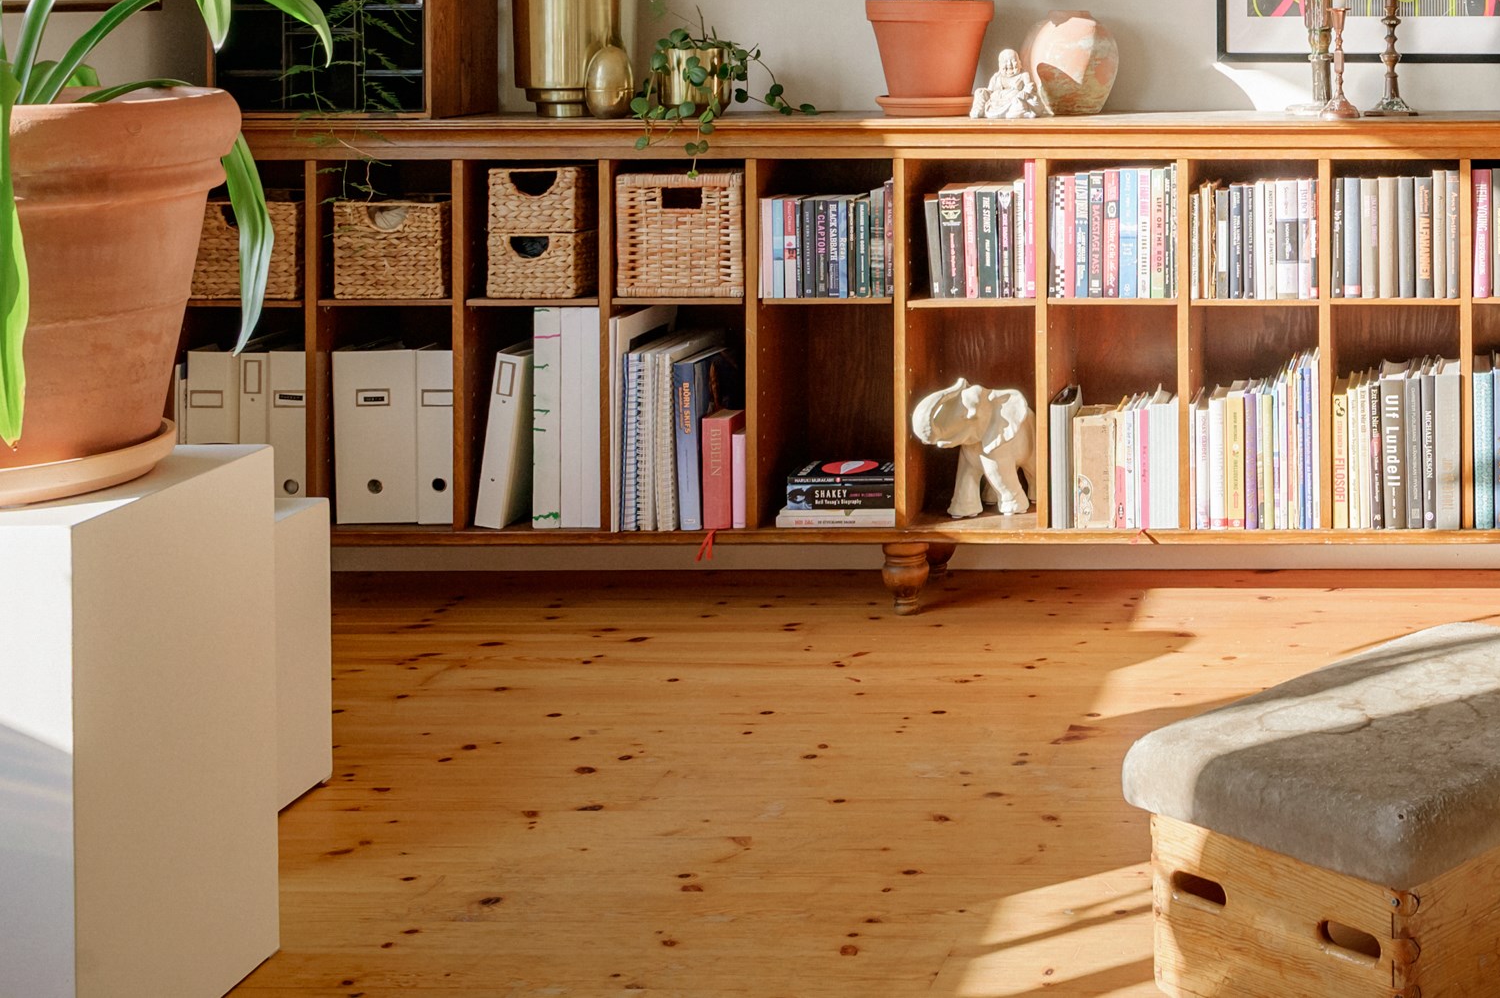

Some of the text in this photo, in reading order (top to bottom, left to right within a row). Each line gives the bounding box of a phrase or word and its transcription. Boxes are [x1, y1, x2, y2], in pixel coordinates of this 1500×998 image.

[830, 204, 838, 227] BLACK
[982, 209, 991, 233] STONES
[1157, 217, 1162, 228] ON
[1476, 184, 1488, 232] NEIL YOUNG
[817, 214, 826, 253] CLAPTON
[830, 228, 838, 261] SABBATH
[1092, 204, 1100, 275] BACKSTAGE PASS
[1419, 218, 1431, 279] ALFAHANNEN
[682, 382, 692, 434] BJÖRN SKIFS
[1385, 395, 1399, 419] Ulf
[710, 428, 722, 476] BIBELN
[1385, 426, 1400, 487] Lundell
[1424, 410, 1433, 479] MICHAEL JACKSON
[814, 489, 848, 499] SHAKEY
[1334, 457, 1345, 503] FILOSOFI
